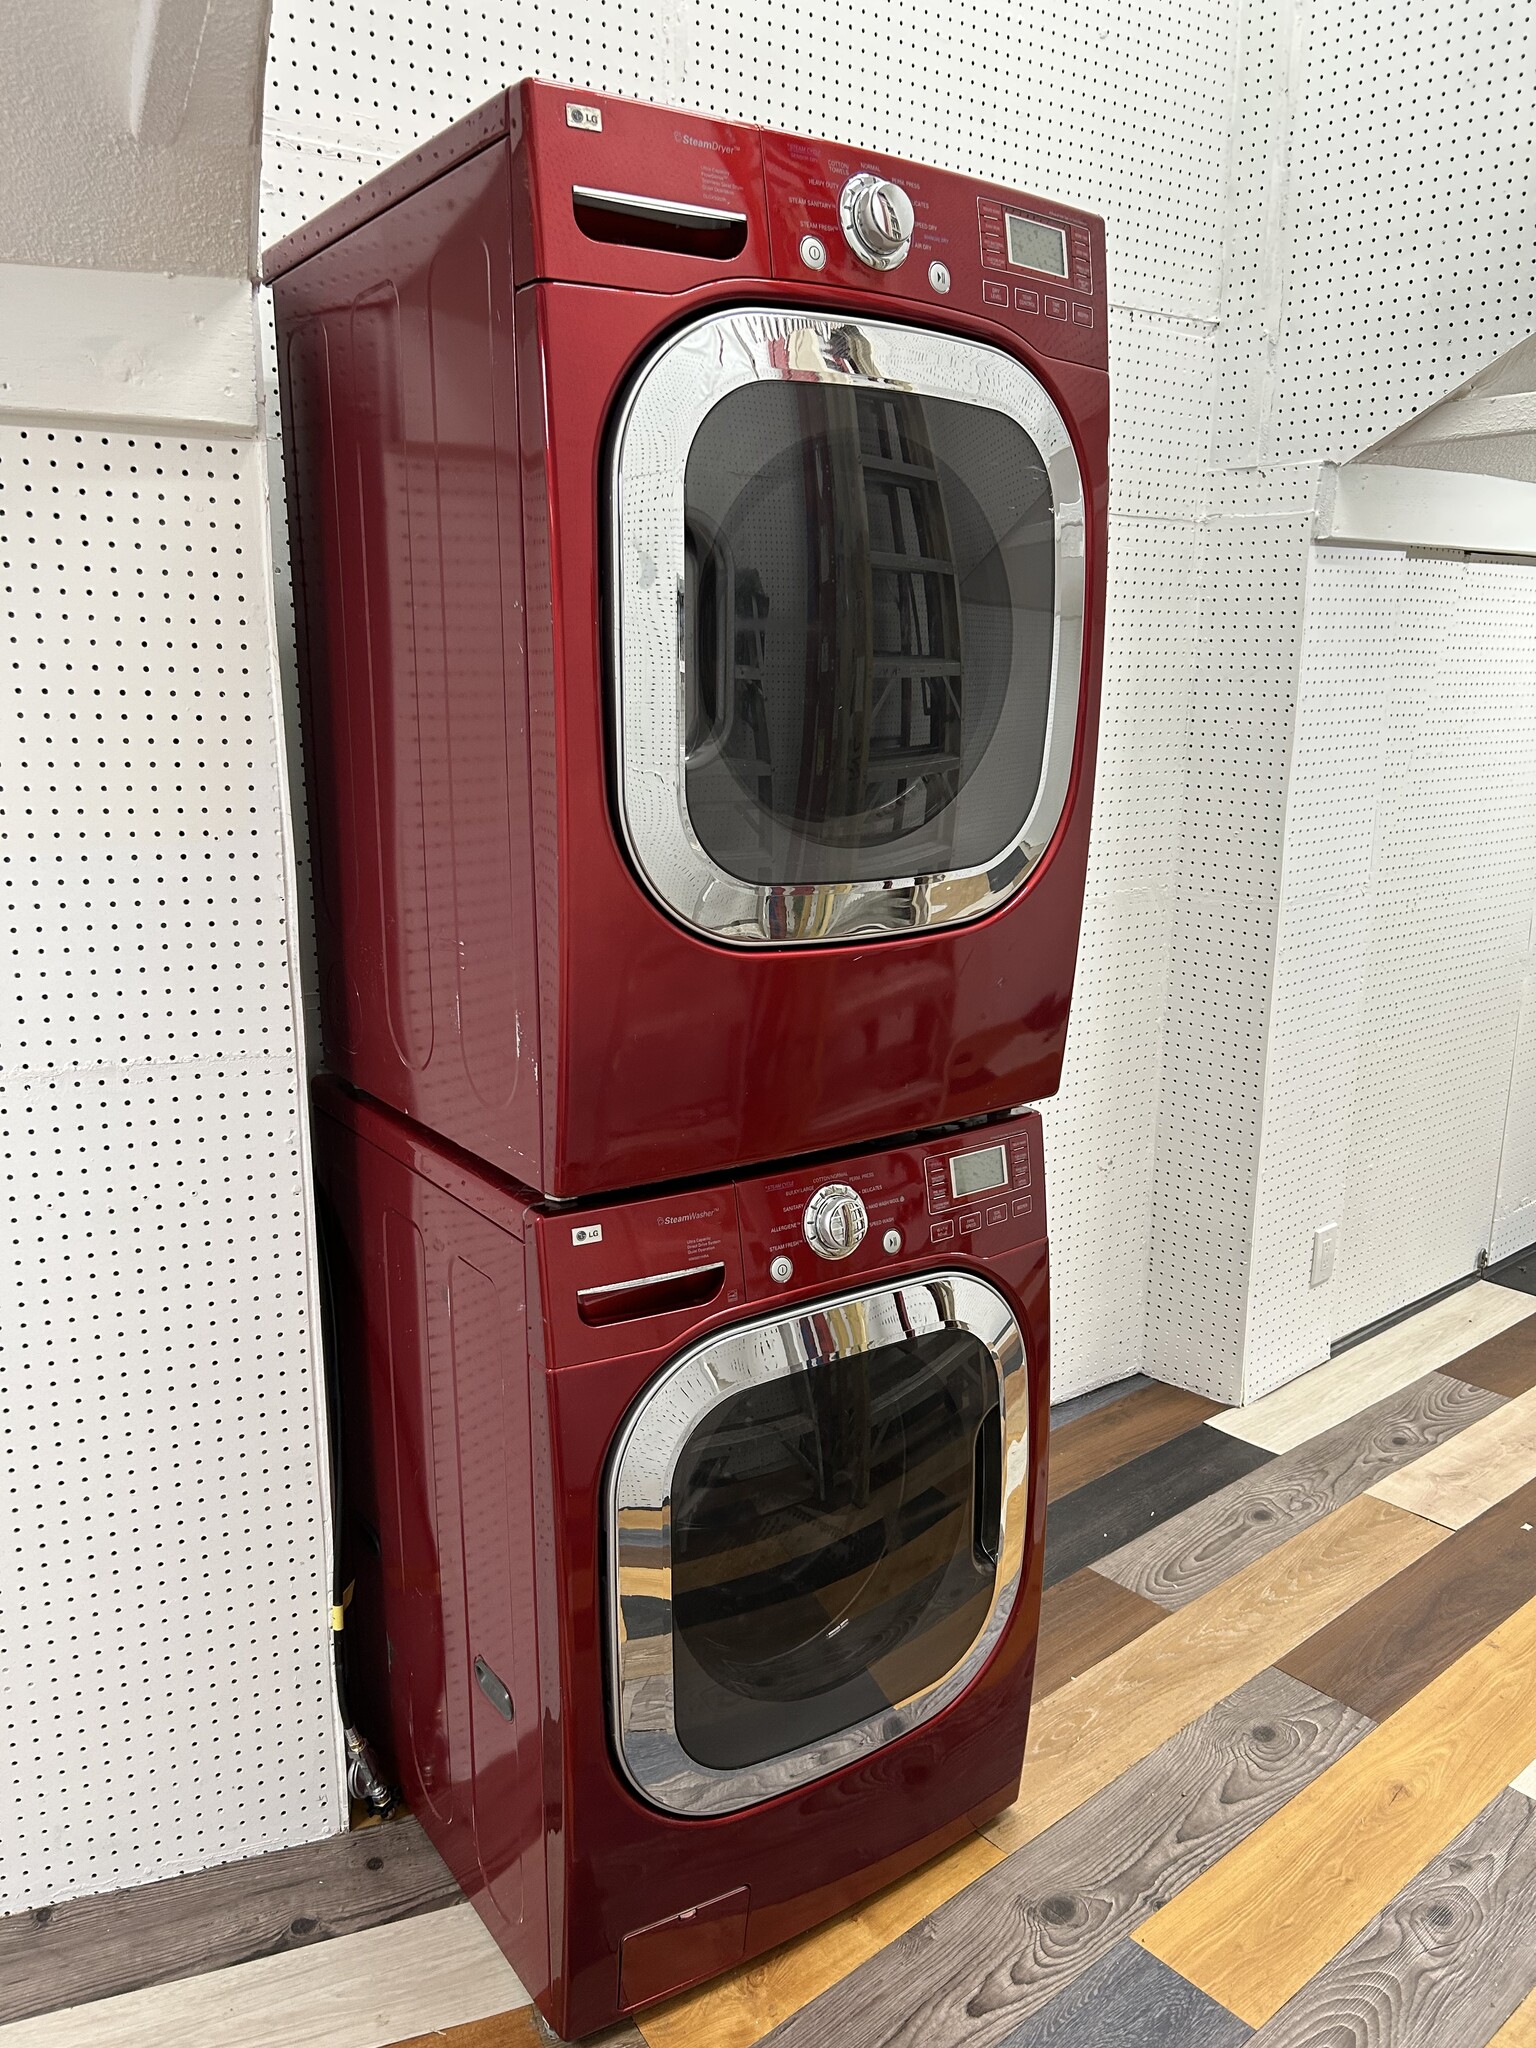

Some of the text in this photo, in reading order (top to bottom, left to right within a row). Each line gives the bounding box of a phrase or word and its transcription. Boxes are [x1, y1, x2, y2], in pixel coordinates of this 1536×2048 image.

[585, 112, 598, 124] LG
[788, 196, 806, 205] STEAM
[800, 220, 818, 229] STEAM
[861, 1184, 883, 1194] DELICATES
[782, 1203, 804, 1213] SANITARY
[588, 1229, 599, 1238] LG
[769, 1243, 785, 1253] STEAM
